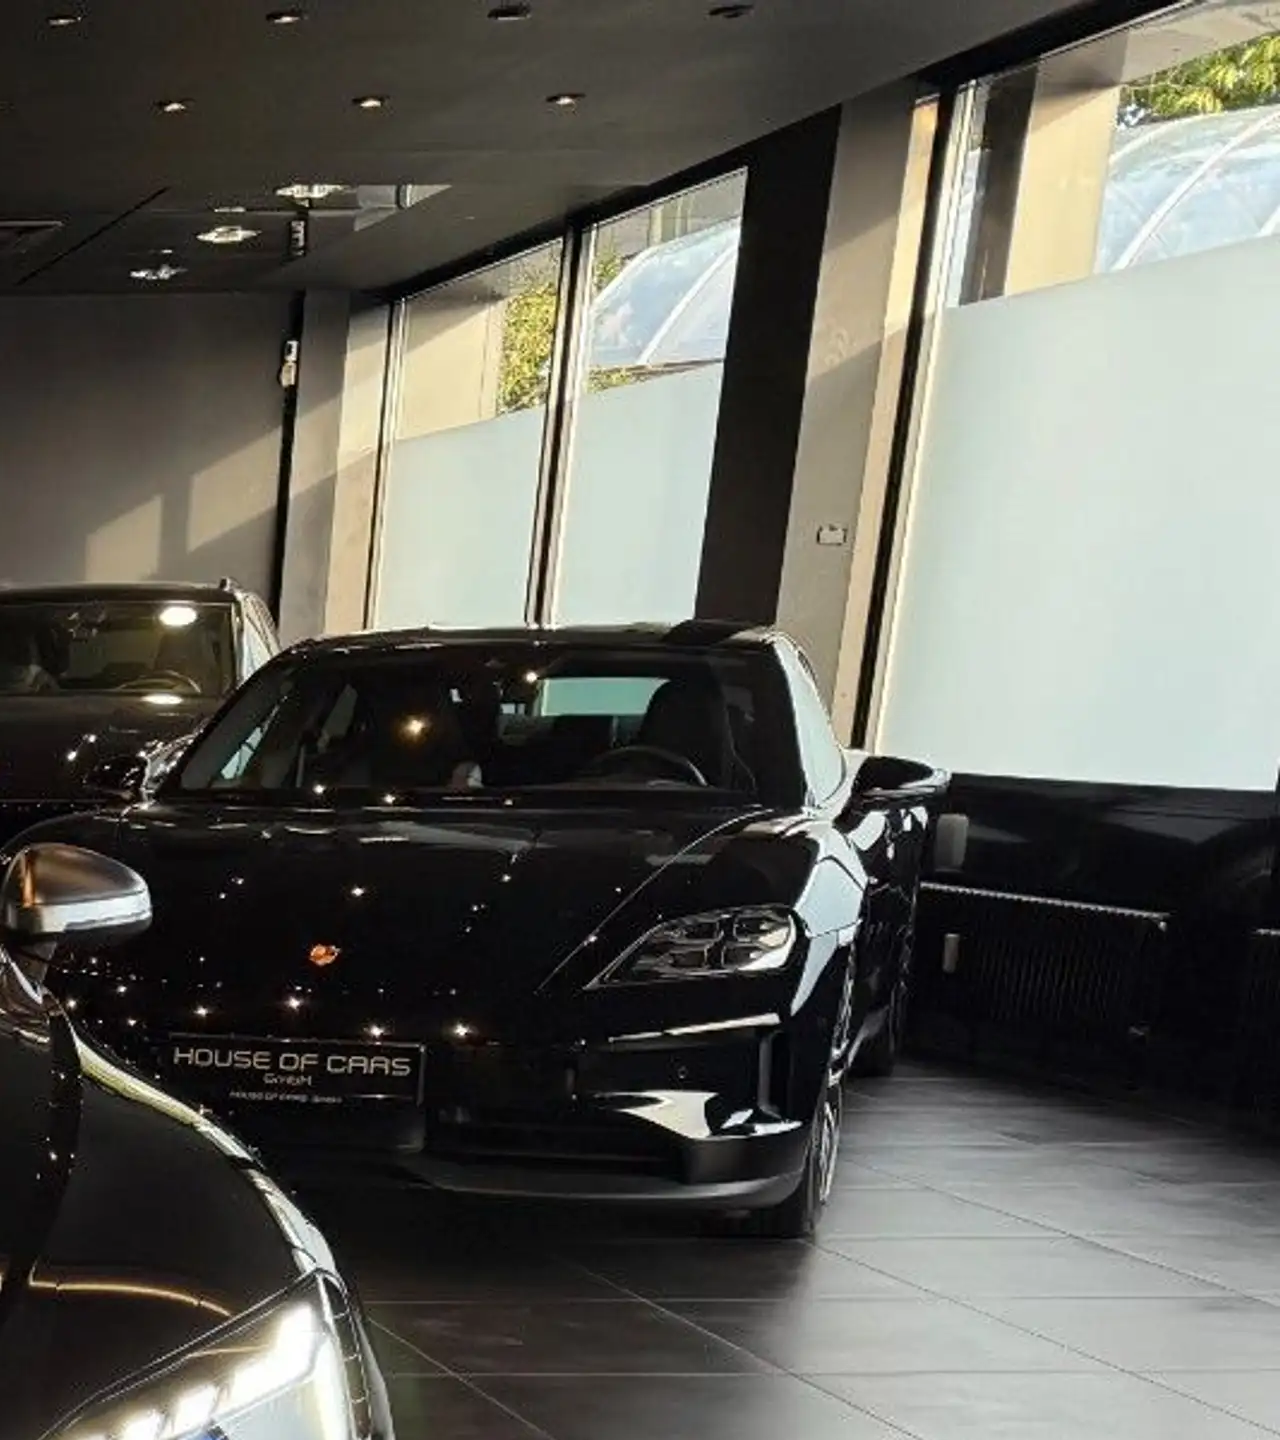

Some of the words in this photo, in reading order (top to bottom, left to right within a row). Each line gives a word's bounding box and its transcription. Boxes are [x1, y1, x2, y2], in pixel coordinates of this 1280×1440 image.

[173, 1047, 271, 1070] HOUSE
[279, 1053, 319, 1072] OF
[326, 1055, 411, 1077] CARS
